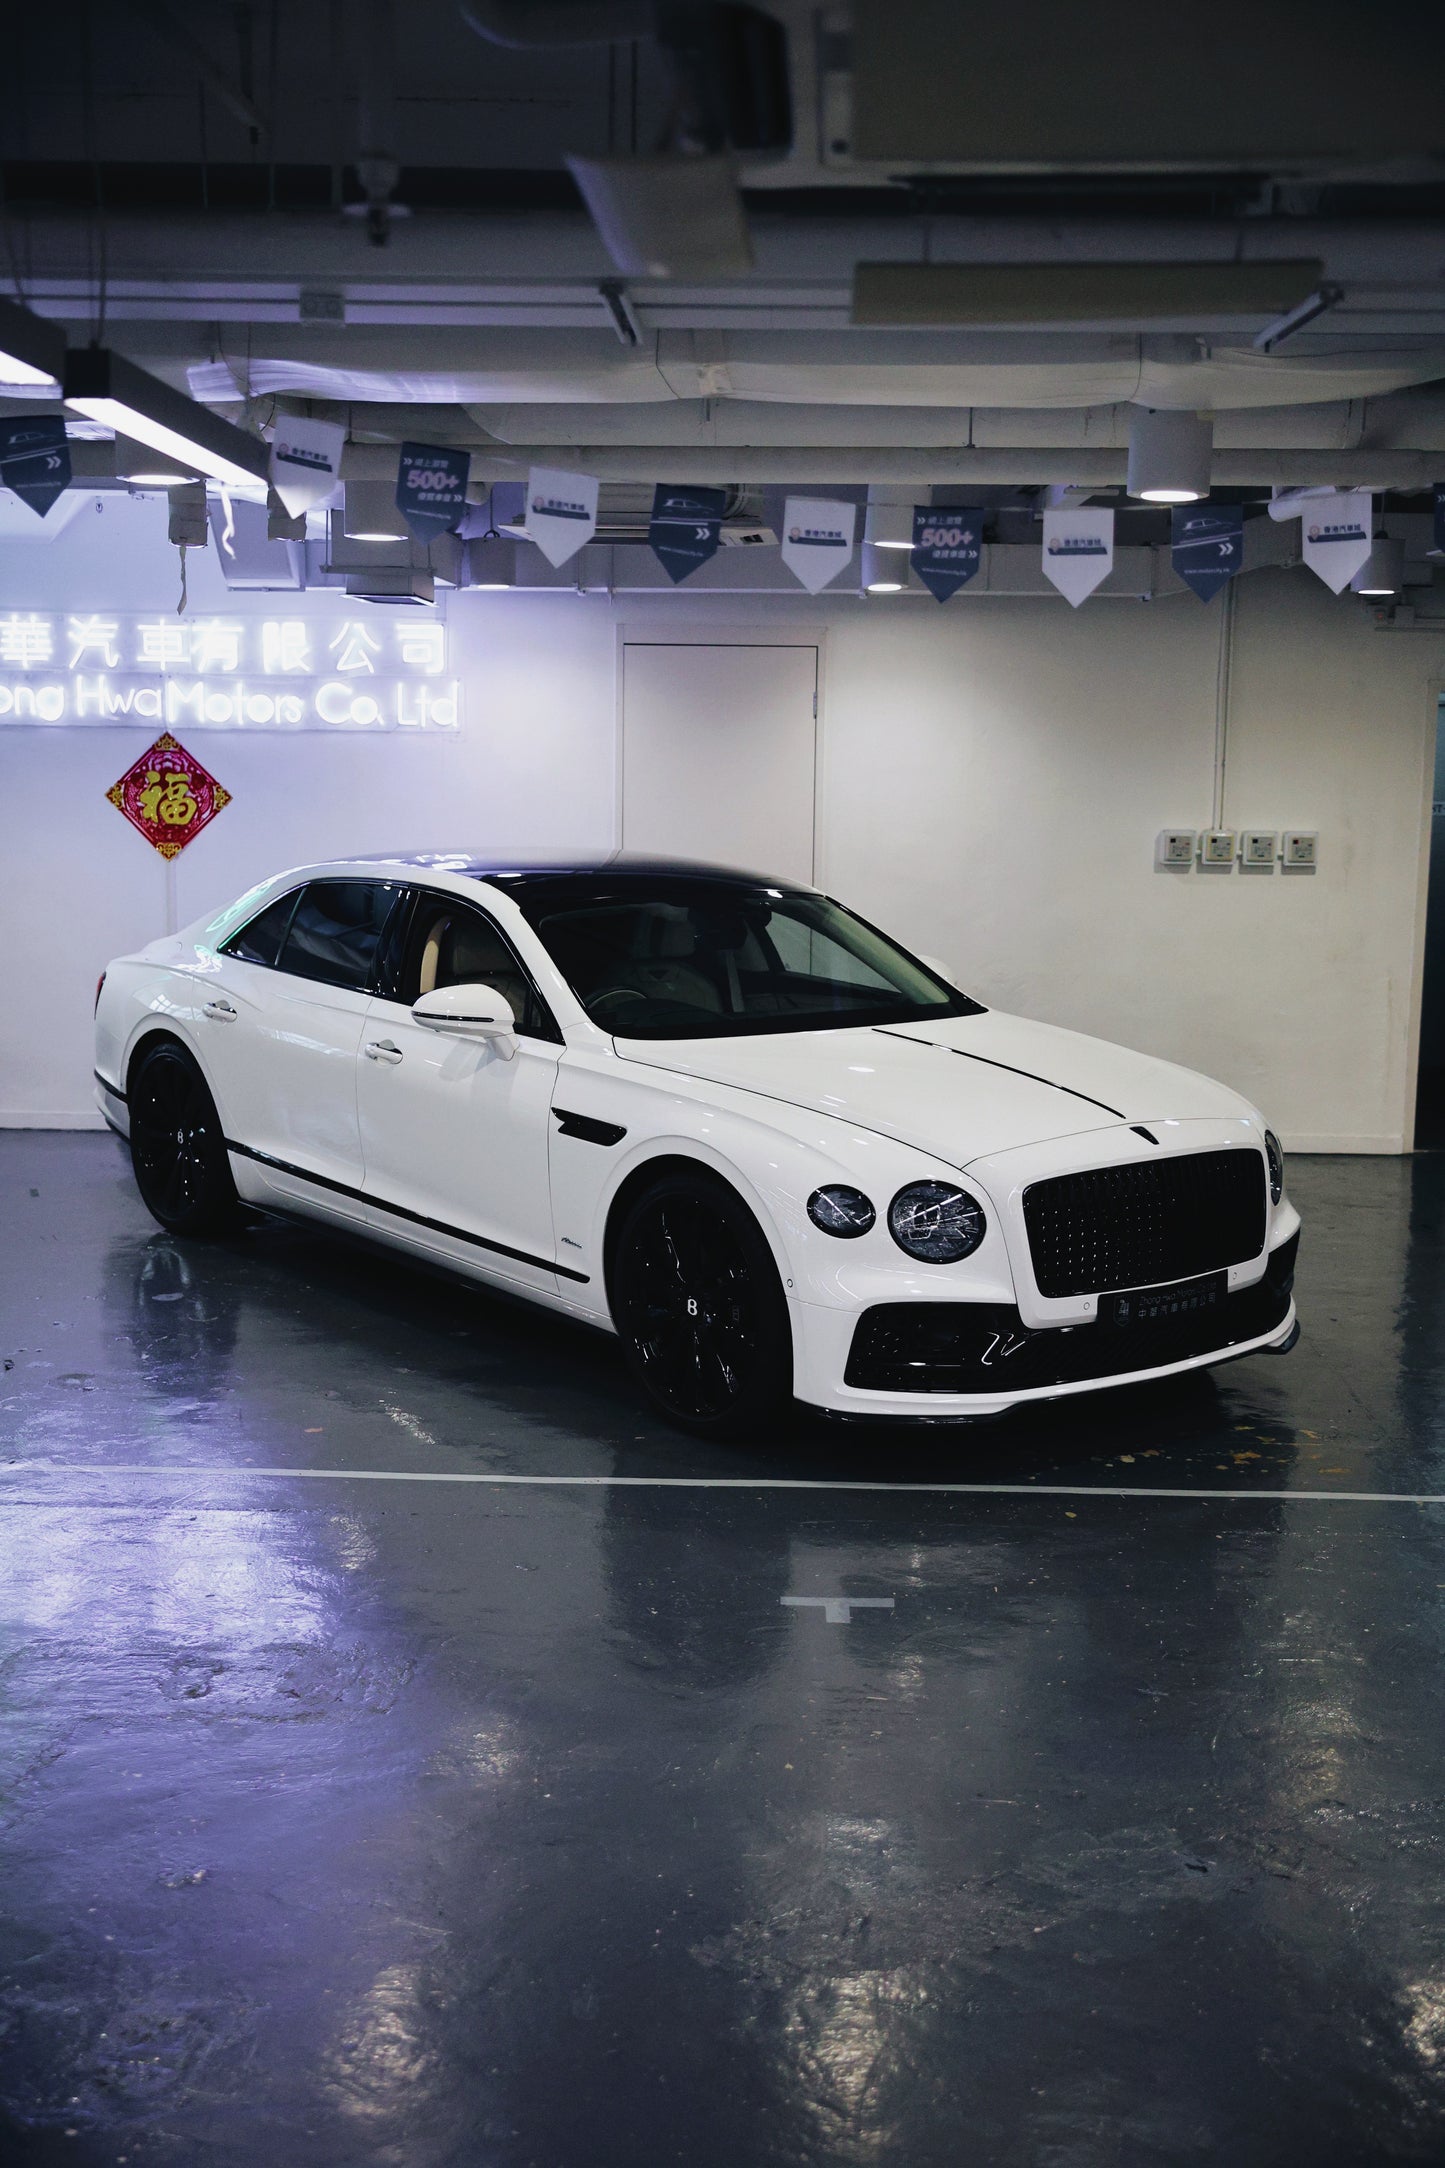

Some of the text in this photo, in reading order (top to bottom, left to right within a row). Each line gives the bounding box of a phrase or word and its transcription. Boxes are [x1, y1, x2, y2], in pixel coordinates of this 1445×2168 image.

[406, 469, 459, 490] 500+
[921, 527, 974, 547] 500+
[0, 614, 444, 673] 華汽車有限公司
[76, 675, 162, 718] Hwa
[168, 681, 304, 726] Motors
[397, 681, 460, 727] Ltd
[140, 771, 198, 825] 福
[687, 1298, 698, 1316] B
